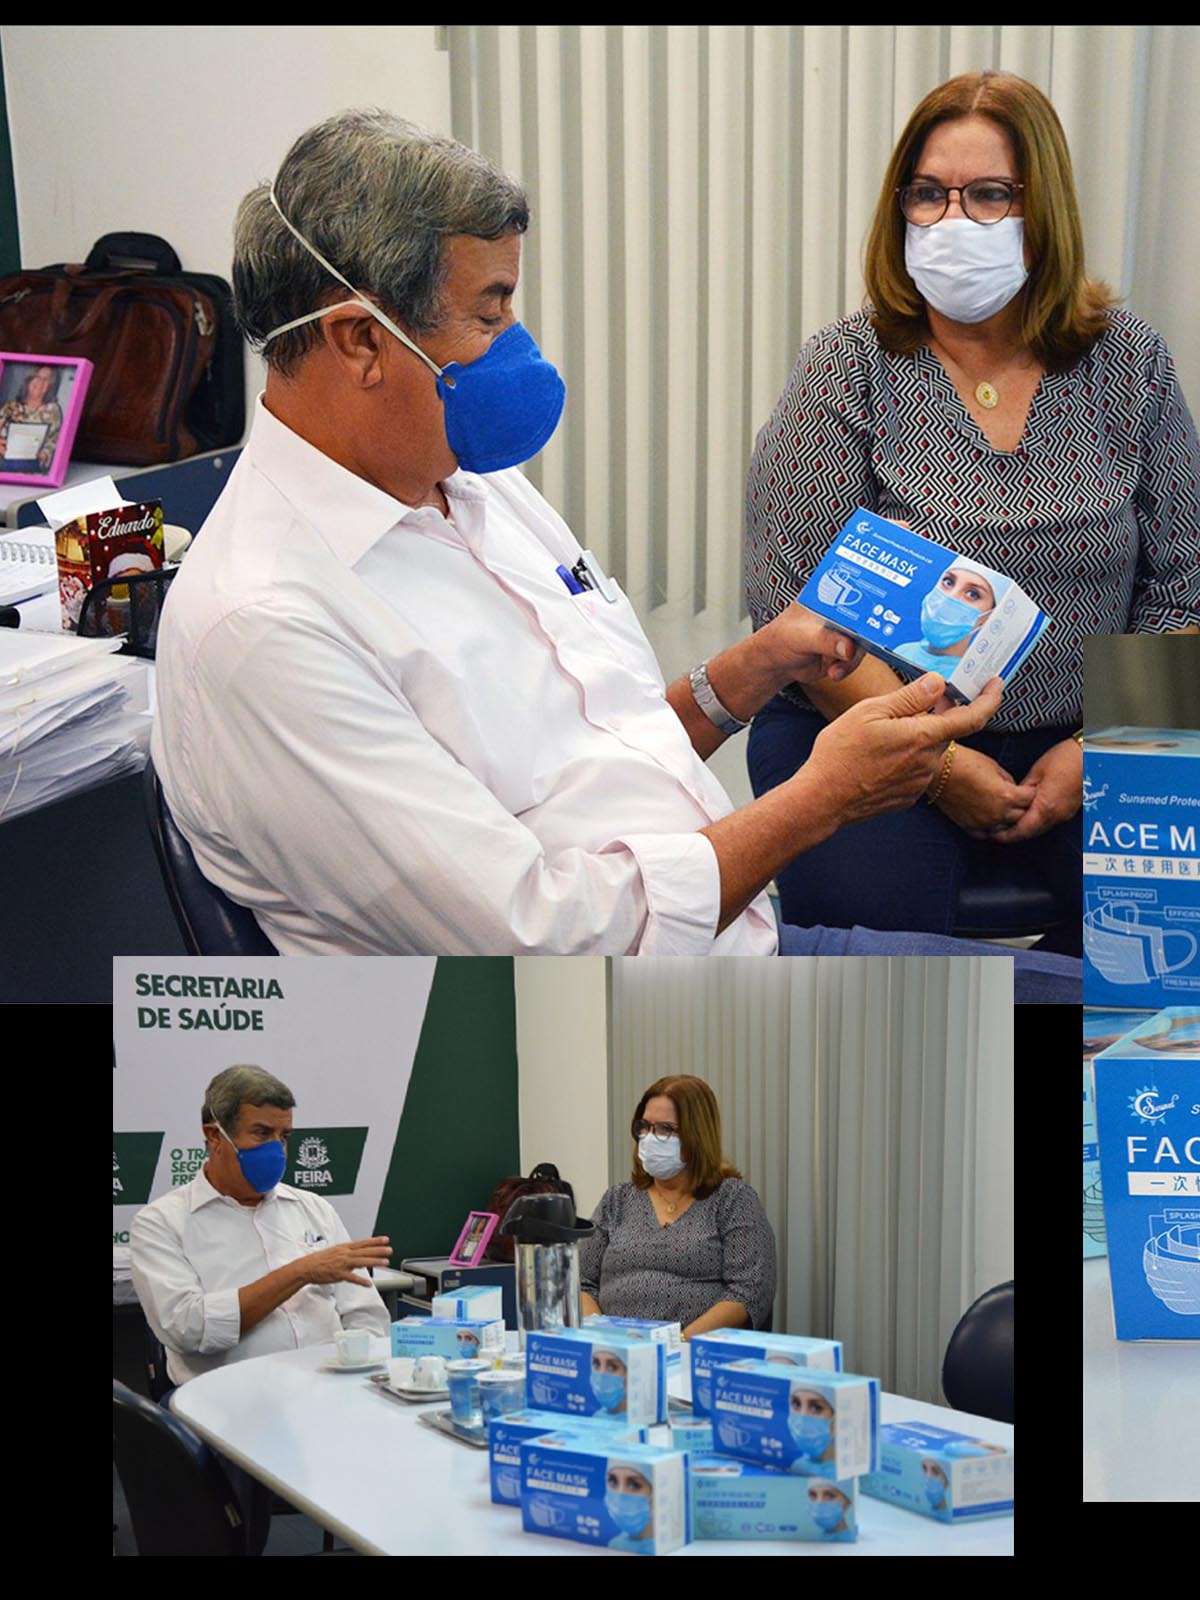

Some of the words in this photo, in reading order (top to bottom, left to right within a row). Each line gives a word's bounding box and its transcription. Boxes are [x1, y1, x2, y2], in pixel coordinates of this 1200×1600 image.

[98, 511, 154, 539] Eduardo
[843, 534, 879, 557] FACE
[878, 550, 918, 576] MASK
[1119, 793, 1168, 806] Sunsmed
[1088, 822, 1160, 850] ACE
[1102, 890, 1130, 898] SPLASH
[1130, 891, 1154, 900] PROOF
[136, 973, 284, 999] SECRETARIA
[138, 1006, 172, 1028] DE
[178, 1002, 264, 1031] SAÚDE
[170, 1148, 183, 1160] O
[294, 1170, 333, 1184] FEIRA
[553, 1356, 578, 1368] MASK
[743, 1395, 772, 1408] MASK
[556, 1472, 588, 1486] MASK
